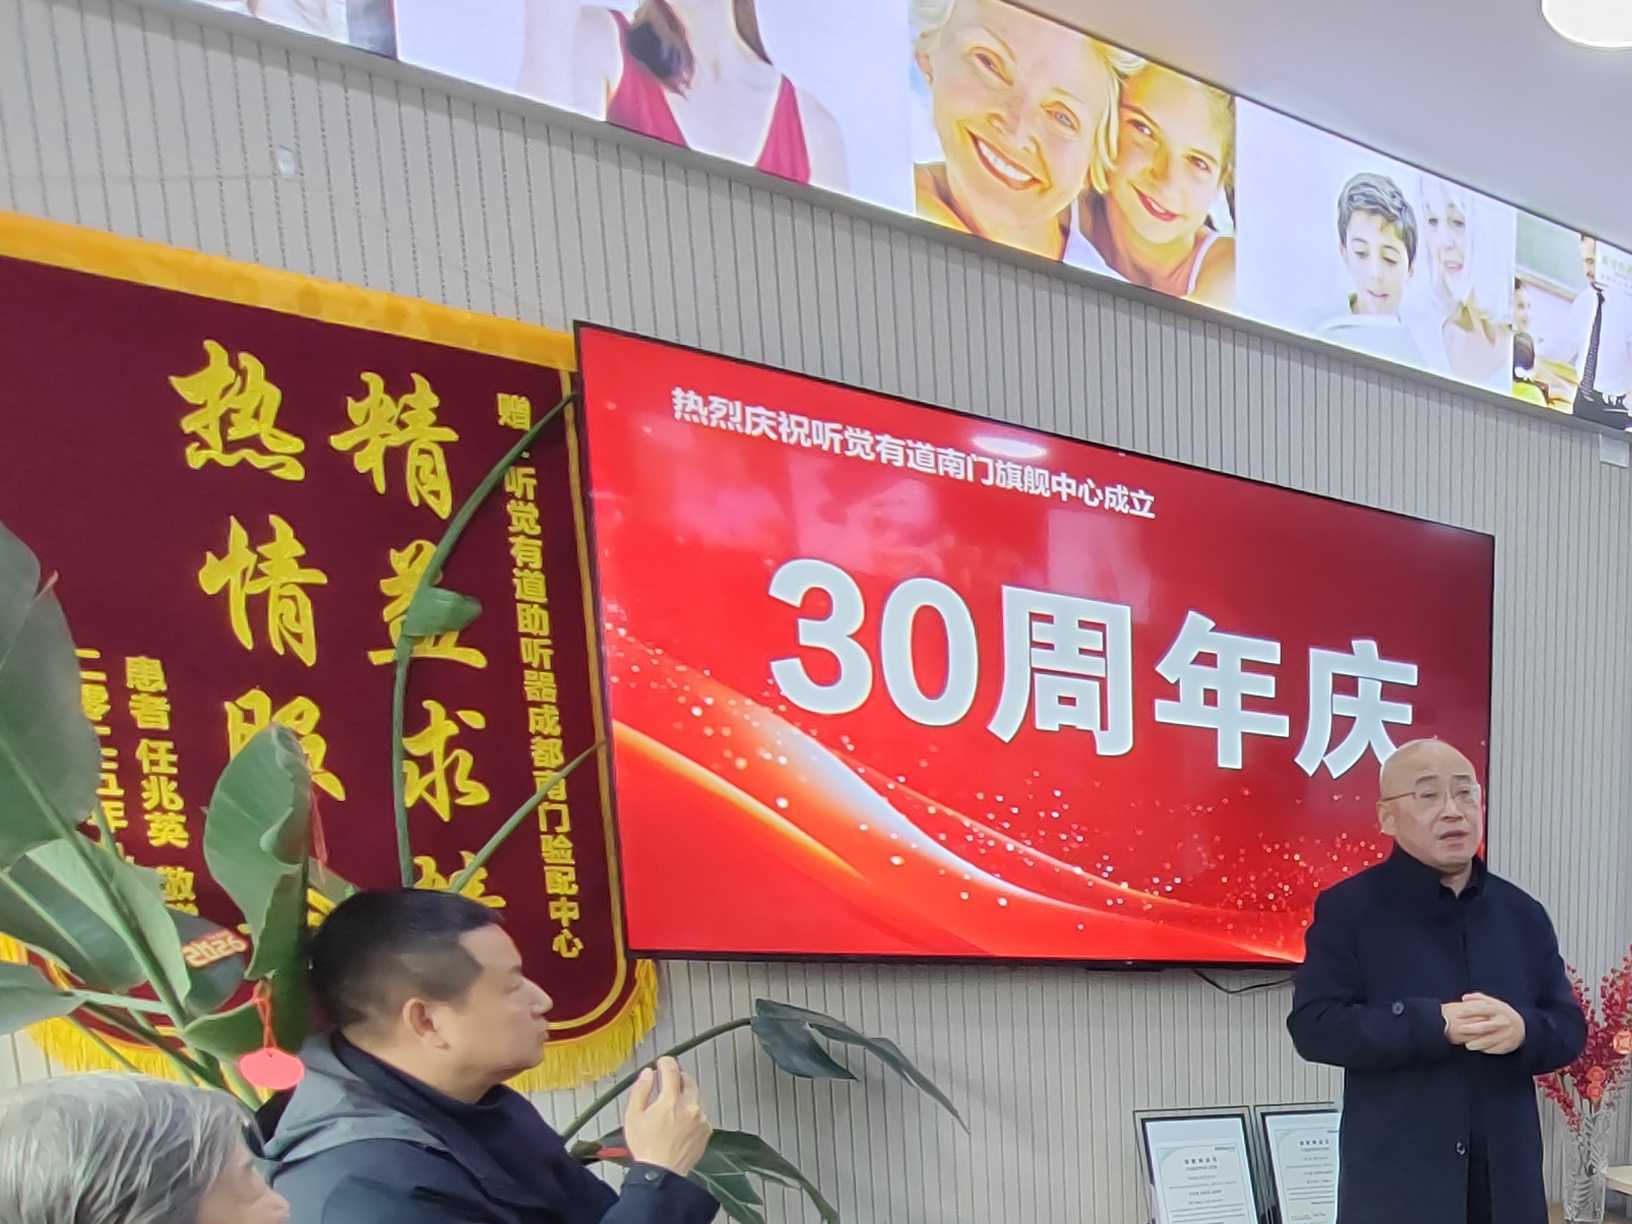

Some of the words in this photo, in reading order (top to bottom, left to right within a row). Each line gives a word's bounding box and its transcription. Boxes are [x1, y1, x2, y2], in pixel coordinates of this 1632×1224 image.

[671, 386, 1157, 519] 热烈庆祝听觉有道南门旗舰中心成立
[125, 655, 171, 730] 患者
[169, 339, 346, 932] 热情服
[767, 556, 1420, 780] 30周年庆
[135, 738, 189, 848] 任兆英
